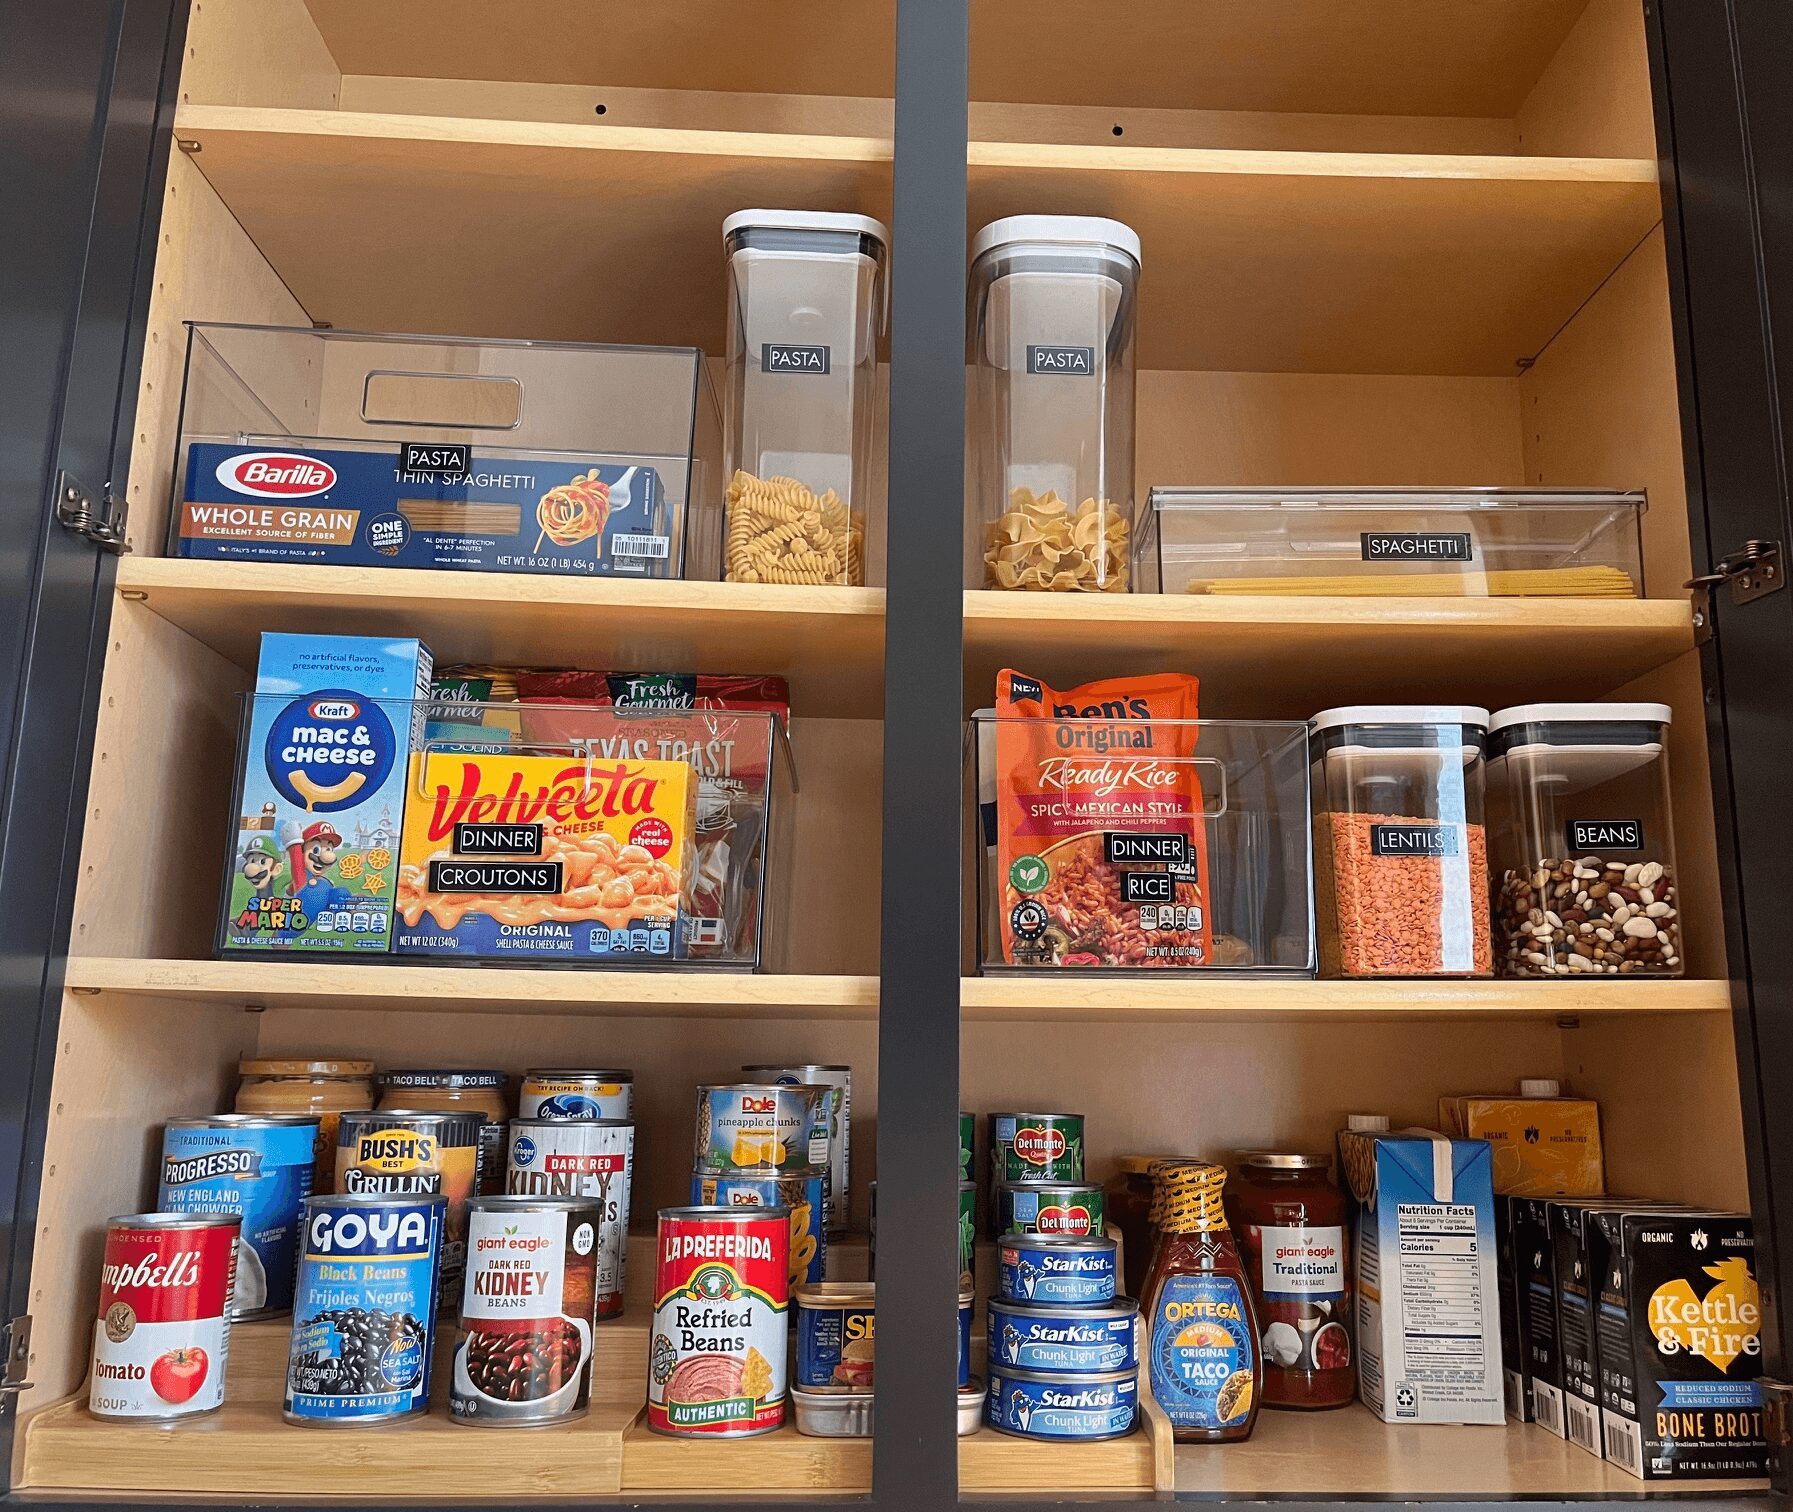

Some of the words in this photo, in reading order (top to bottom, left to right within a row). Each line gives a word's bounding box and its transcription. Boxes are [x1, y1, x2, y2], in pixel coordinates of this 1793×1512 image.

[772, 350, 822, 368] PASTA
[1037, 350, 1086, 368] PASTA
[410, 450, 462, 467] PASTA
[244, 463, 327, 486] Barilla
[394, 469, 434, 485] THIN
[442, 472, 536, 490] SPAGHETTI
[191, 506, 273, 526] WHOLE
[281, 511, 352, 531] GRAIN
[204, 526, 253, 537] EXCELLENT
[256, 529, 292, 538] SOURCE
[295, 531, 308, 539] OF
[311, 532, 336, 540] FIBER
[372, 521, 403, 533] ONE
[373, 532, 404, 541] SIMPLE
[1371, 540, 1458, 554] SPAGHETTI
[497, 556, 512, 566] NET
[529, 558, 535, 567] 16
[538, 558, 549, 567] OZ
[573, 560, 587, 569] 454
[299, 653, 310, 661] no
[312, 653, 347, 661] artificial
[349, 654, 380, 664] flavors,
[292, 662, 352, 672] preservatives,
[365, 664, 385, 675] dyes
[626, 680, 681, 698] Fresh
[319, 704, 349, 717] Kraft
[615, 693, 695, 715] Gourmet
[1053, 696, 1151, 720] Ben's
[293, 726, 348, 744] mac
[351, 726, 371, 746] &
[1056, 724, 1153, 754] Original
[657, 739, 735, 778] TOAST
[1039, 757, 1127, 797] Ready
[1118, 758, 1180, 789] Rice
[428, 763, 660, 842] Velveeta
[1031, 804, 1071, 817] SPICY
[1075, 802, 1143, 815] MEXICAN
[554, 821, 605, 836] CHEESE
[636, 821, 652, 835] MADE
[1105, 819, 1120, 827] AND
[463, 830, 535, 848] DINNER
[642, 829, 660, 837] real
[1381, 832, 1445, 848] LENTILS
[1577, 827, 1636, 843] BEANS
[632, 836, 669, 847] cheese
[1114, 840, 1182, 857] DINNER
[441, 869, 548, 886] CROUTONS
[1130, 879, 1169, 895] RICE
[248, 896, 304, 912] SUPER
[1141, 907, 1156, 918] 240
[237, 911, 310, 932] MARIO
[501, 925, 573, 938] ORIGINAL
[592, 931, 608, 941] 370
[400, 936, 411, 946] NET
[496, 939, 512, 949] SHELL
[513, 939, 530, 949] PASTA
[536, 940, 556, 950] CHEESE
[1146, 947, 1157, 957] NET
[393, 1076, 413, 1085] TACO
[415, 1076, 438, 1086] BELL
[479, 1076, 497, 1086] BELL
[742, 1096, 777, 1113] Dole
[718, 1117, 764, 1128] pineapple
[180, 1136, 232, 1147] TRADITIONAL
[1018, 1137, 1033, 1149] Del
[1034, 1138, 1063, 1150] Monte
[360, 1139, 432, 1162] BUSH'S
[166, 1153, 251, 1183] PROGRESSO
[382, 1160, 404, 1168] BEST
[551, 1158, 585, 1171] DARK
[590, 1157, 618, 1170] RED
[345, 1170, 440, 1194] GRILLIN'
[509, 1171, 614, 1200] KIDNEY
[1185, 1183, 1210, 1194] MEDIUM
[168, 1190, 186, 1203] NEW
[190, 1189, 240, 1203] ENGLAND
[733, 1193, 759, 1206] Dole
[1399, 1206, 1443, 1216] Nutrition
[1446, 1207, 1475, 1217] Facts
[1041, 1217, 1057, 1229] Del
[1059, 1217, 1088, 1229] Monte
[312, 1212, 427, 1252] GOYA
[1642, 1232, 1674, 1243] ORGANIC
[1736, 1231, 1745, 1239] NO
[477, 1237, 507, 1252] giant
[509, 1236, 550, 1253] eagle
[665, 1237, 681, 1263] LA
[683, 1235, 772, 1262] PREFERIDA
[1401, 1243, 1434, 1252] Calories
[1470, 1243, 1477, 1252] 5
[1276, 1246, 1306, 1259] giant
[1307, 1245, 1335, 1259] eagle
[489, 1260, 511, 1270] DARK
[514, 1260, 531, 1269] RED
[1041, 1256, 1106, 1272] StarKist
[1273, 1261, 1338, 1275] Traditional
[320, 1265, 357, 1281] Black
[363, 1264, 408, 1281] Beans
[474, 1271, 550, 1296] KIDNEY
[1045, 1282, 1078, 1293] Chunk
[1079, 1283, 1097, 1296] Light
[309, 1290, 360, 1309] Frijoles
[365, 1289, 415, 1306] Negros
[488, 1298, 528, 1307] BEANS
[1165, 1302, 1242, 1322] ORTEGA
[1651, 1293, 1759, 1325] Kettle
[676, 1305, 753, 1328] Refried
[1029, 1324, 1105, 1342] StarKist
[1186, 1325, 1224, 1339] MEDIUM
[390, 1337, 417, 1355] Now
[680, 1330, 746, 1351] Beans
[1657, 1326, 1680, 1355] &
[1687, 1327, 1761, 1356] Fire
[1032, 1349, 1067, 1361] Chunk
[1070, 1349, 1096, 1364] Light
[1110, 1349, 1128, 1361] WATER
[1180, 1348, 1230, 1358] ORIGINAL
[383, 1359, 402, 1369] SEA
[402, 1355, 421, 1367] SALT
[95, 1358, 147, 1381] Tomato
[320, 1369, 338, 1380] NETO
[1182, 1363, 1230, 1379] TACO
[1194, 1379, 1219, 1387] SAUCE
[1675, 1384, 1717, 1393] REDUCED
[1718, 1384, 1752, 1393] SODIUM
[97, 1397, 129, 1411] SOUP
[301, 1398, 335, 1408] PRIME
[342, 1396, 401, 1408] PREMIUM
[1040, 1390, 1115, 1407] StarKist
[1675, 1396, 1713, 1404] CLASSIC
[1714, 1396, 1753, 1404] CHICKEN
[674, 1402, 747, 1421] AUTHENTIC
[1045, 1415, 1080, 1427] Chunk
[1084, 1415, 1108, 1429] Light
[1656, 1412, 1706, 1438] BONE
[1714, 1412, 1761, 1438] BROT
